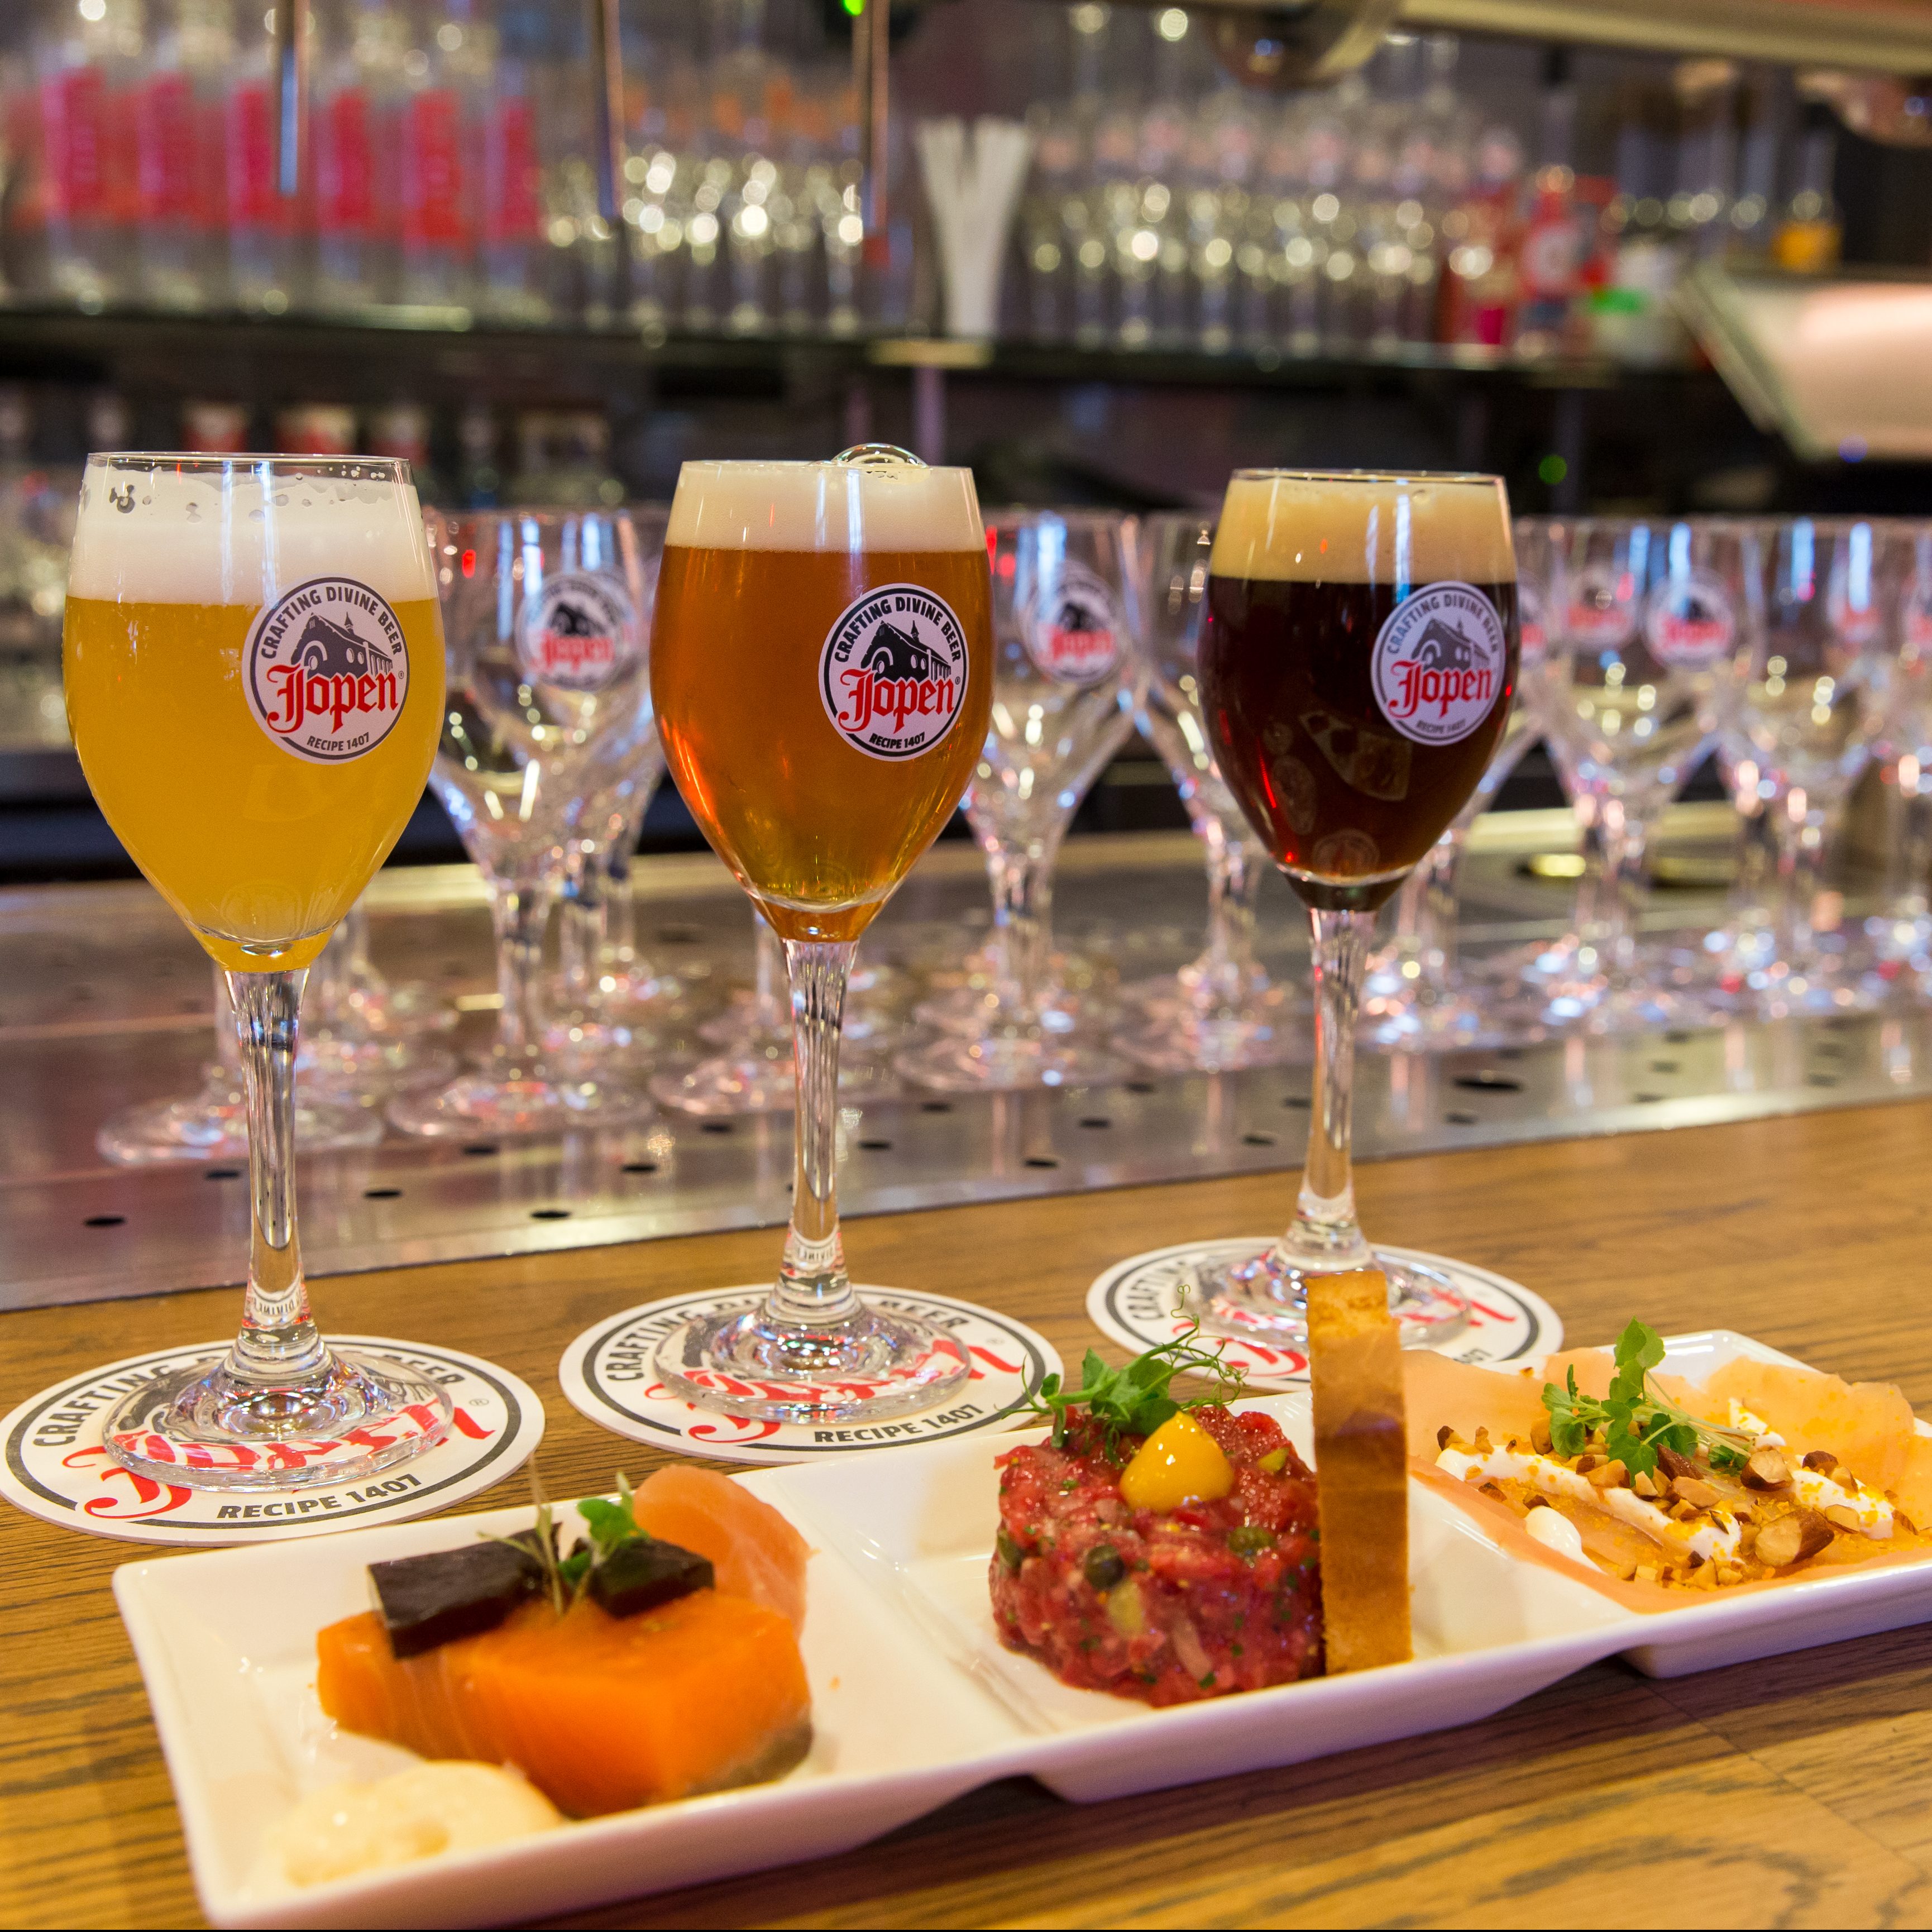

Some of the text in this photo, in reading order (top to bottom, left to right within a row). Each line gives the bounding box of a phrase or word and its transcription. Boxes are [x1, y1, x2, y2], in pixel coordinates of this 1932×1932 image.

[261, 586, 402, 659] CRAFTING DIVINE BEER
[834, 596, 961, 663] CRAFTING DIVINE BEER
[1387, 596, 1440, 654] CRAFTING
[266, 663, 398, 734] Jopen
[838, 668, 954, 734] Jopen
[1387, 660, 1492, 718] Jopen
[307, 732, 369, 751] RECIPE 1407
[869, 731, 925, 749] RECIPE 1407
[814, 1404, 984, 1442] RECIPE 1407
[217, 1474, 422, 1518] RECIPE 1407
